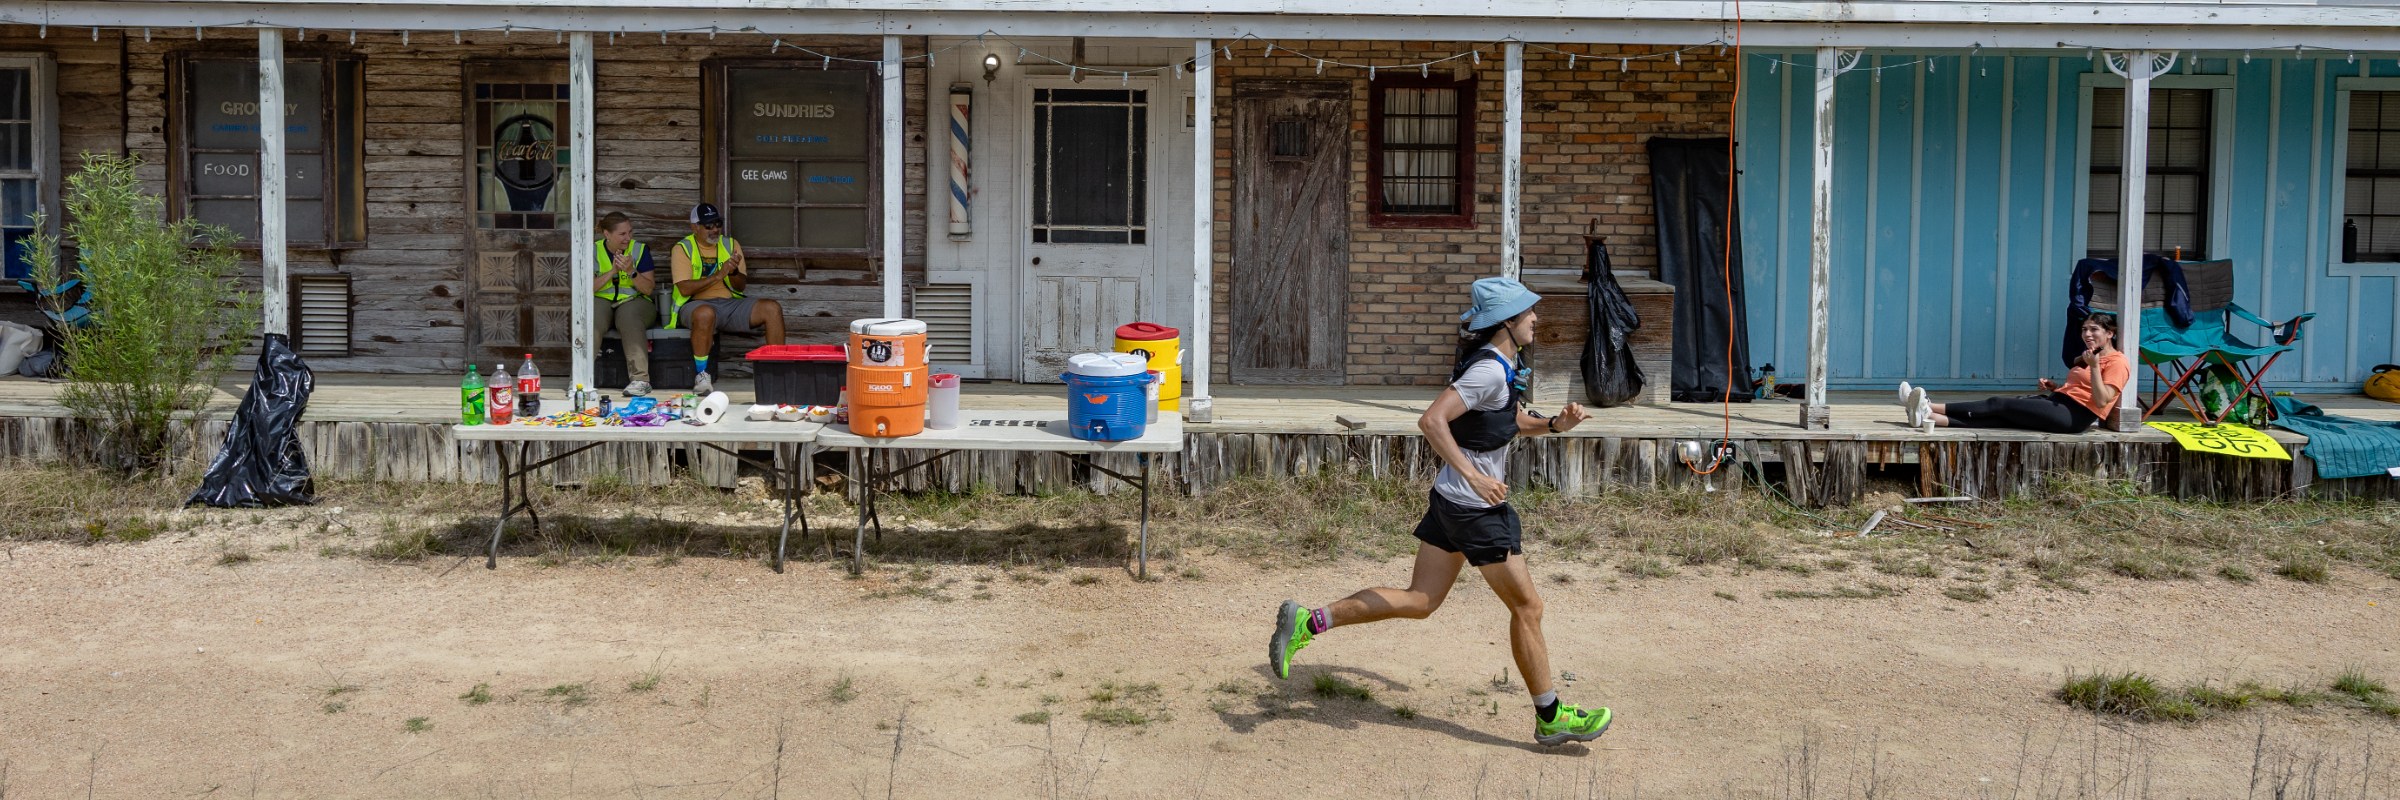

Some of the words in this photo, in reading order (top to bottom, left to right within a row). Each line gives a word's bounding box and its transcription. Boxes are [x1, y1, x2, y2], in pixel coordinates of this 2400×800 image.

[753, 102, 835, 118] SUNDRIES
[204, 163, 249, 177] FOOD
[741, 169, 759, 181] GEE
[761, 169, 788, 181] GAWS
